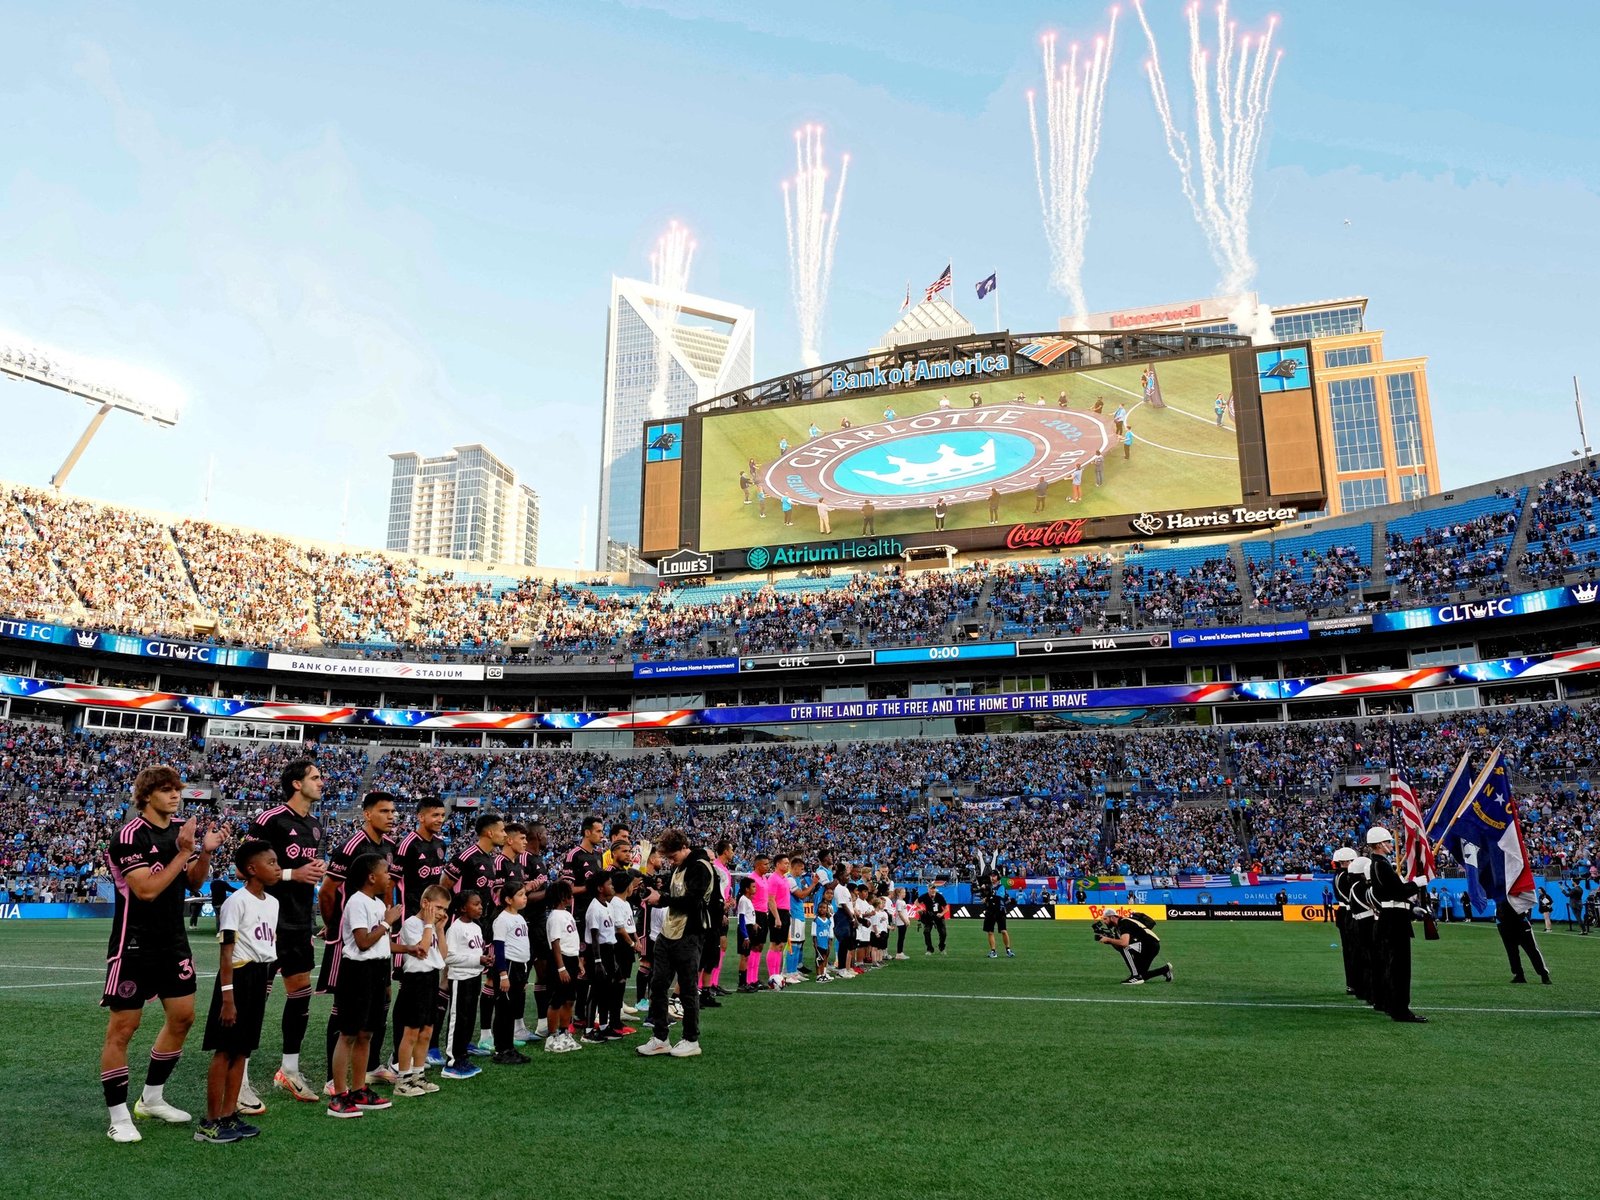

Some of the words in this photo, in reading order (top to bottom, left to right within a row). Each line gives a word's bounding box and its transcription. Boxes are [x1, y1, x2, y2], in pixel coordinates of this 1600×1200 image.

[1111, 304, 1201, 328] Honeywell
[831, 366, 888, 391] Bank
[888, 361, 914, 384] of
[914, 353, 1009, 381] America
[789, 410, 1026, 468] CHARLOTTE
[1029, 449, 1087, 478] CLUB
[1166, 512, 1231, 530] Harris
[1232, 506, 1297, 524] Teeter
[773, 545, 839, 565] Atrium
[841, 538, 902, 559] Health
[663, 558, 708, 574] LOWE'S
[31, 625, 51, 640] FC
[1199, 633, 1220, 641] Lowe's
[1260, 628, 1303, 638] Improvement
[929, 646, 960, 659] 0:00
[1043, 642, 1053, 652] 0
[1092, 638, 1117, 650] MIA
[292, 661, 322, 671] BANK
[324, 663, 338, 672] OF
[340, 664, 388, 675] AMERICA
[416, 669, 463, 678] STADIUM
[778, 656, 810, 668] CLTFC
[837, 654, 845, 665] 0
[791, 706, 812, 719] O'ER
[816, 705, 834, 718] THE
[836, 704, 863, 717] LAND
[866, 703, 879, 716] OF
[882, 702, 900, 714] THE
[904, 701, 928, 714] FREE
[932, 700, 953, 712] AND
[956, 699, 976, 711] THE
[979, 698, 1008, 711] HOME
[1012, 697, 1025, 709] OF
[1028, 695, 1048, 708] THE
[1052, 693, 1087, 707] BRAVE
[1482, 783, 1495, 798] N
[254, 922, 276, 947] ally
